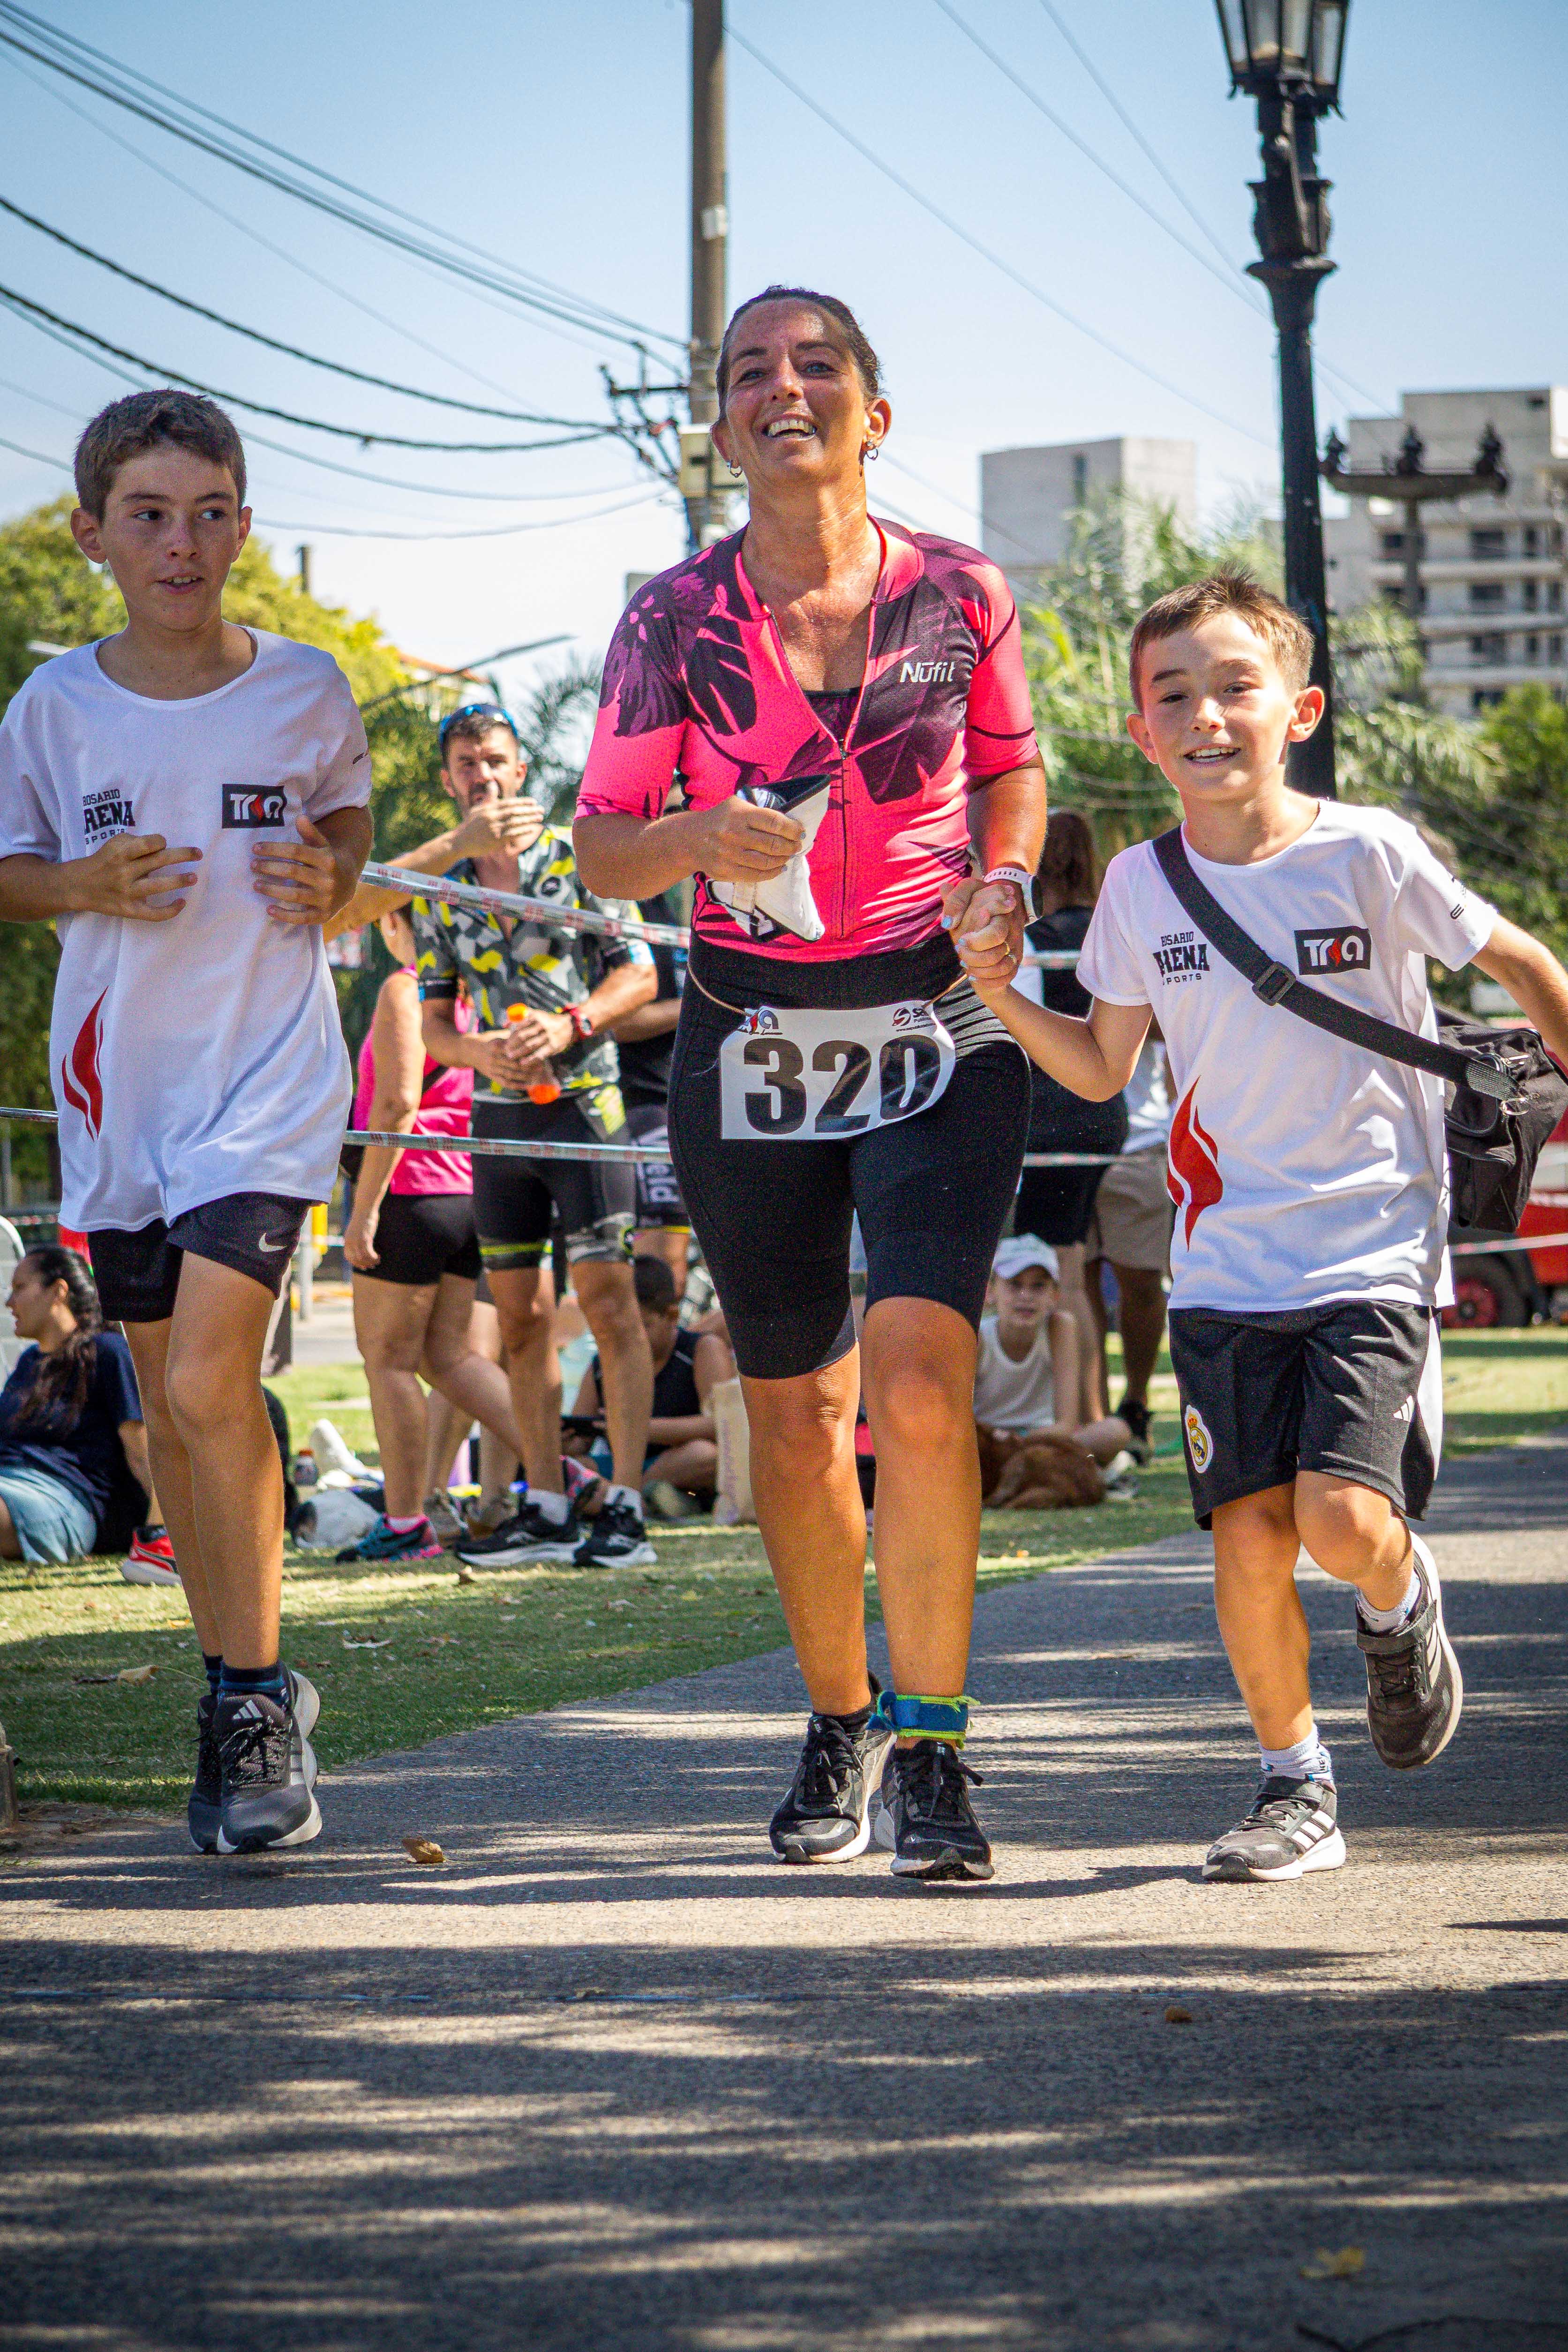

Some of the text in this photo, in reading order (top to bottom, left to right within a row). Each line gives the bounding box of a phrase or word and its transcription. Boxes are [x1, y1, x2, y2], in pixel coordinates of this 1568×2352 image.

[83, 801, 136, 835] RENA
[1163, 973, 1202, 985] PORTS
[743, 1034, 941, 1135] 320
